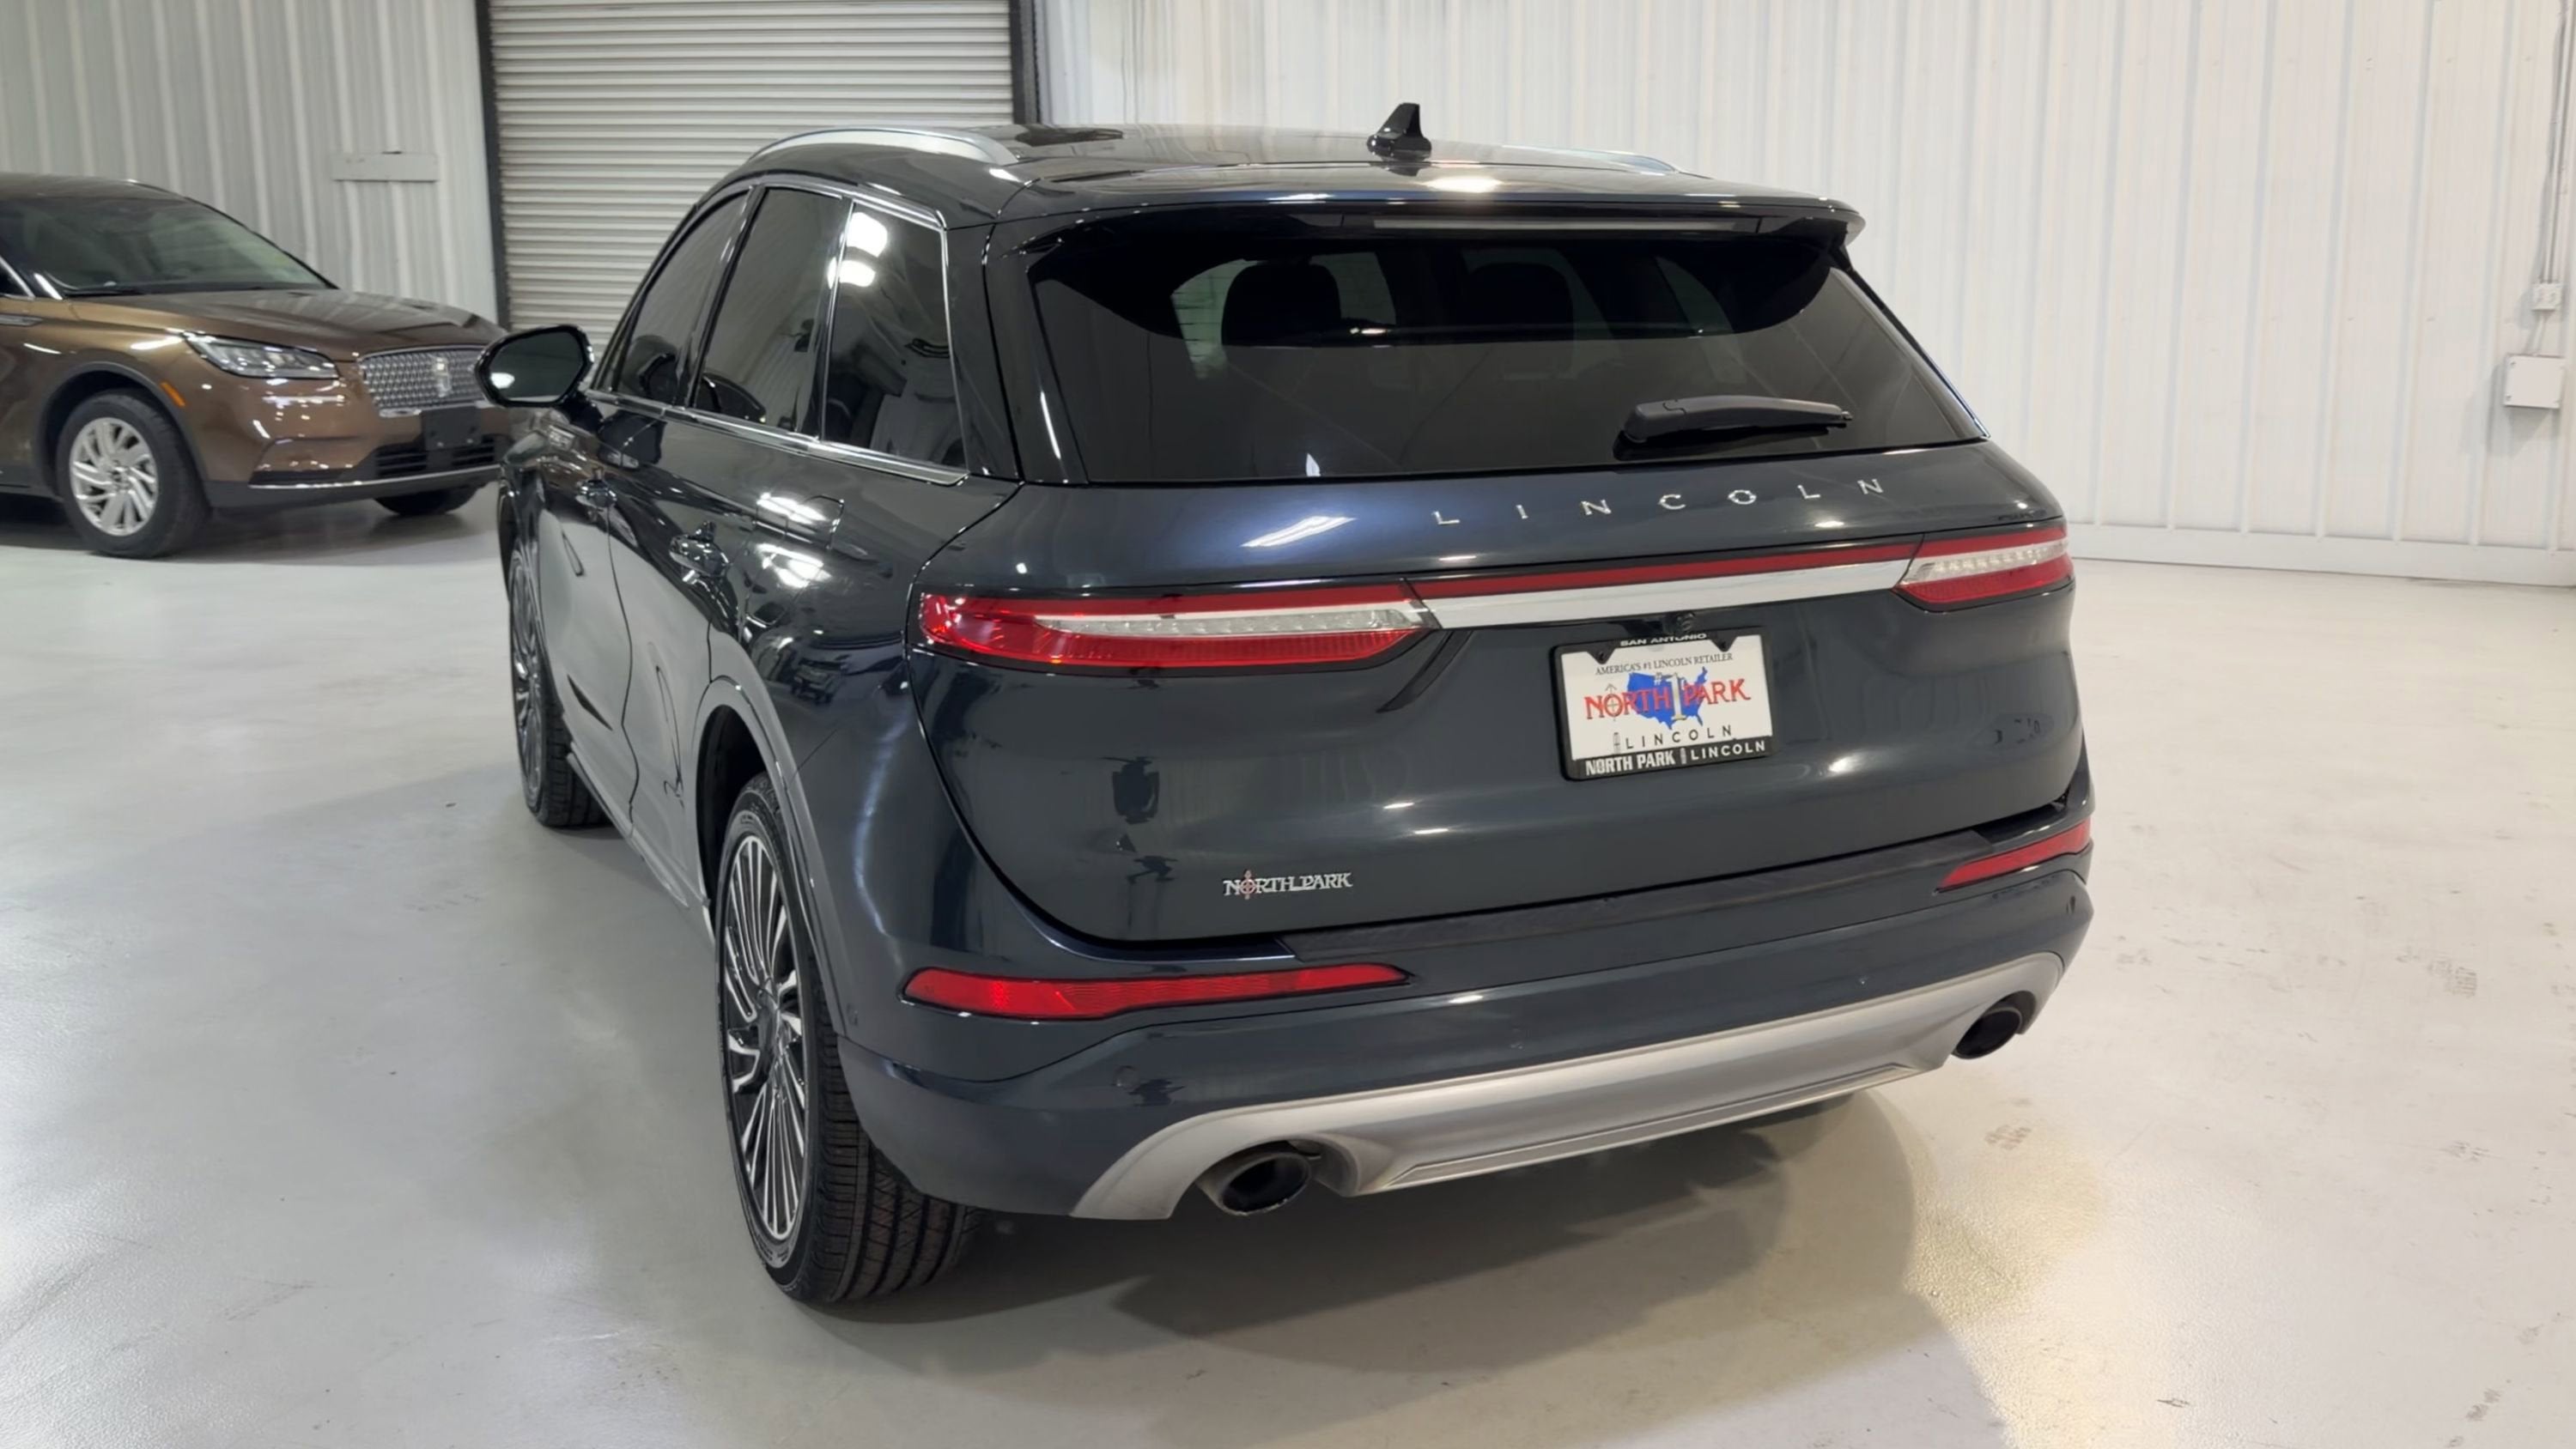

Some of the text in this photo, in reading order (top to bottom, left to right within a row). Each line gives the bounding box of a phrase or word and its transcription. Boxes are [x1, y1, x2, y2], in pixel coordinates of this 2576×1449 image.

[1433, 478, 1884, 525] LINCOLN
[1650, 633, 1707, 644] ANTONIO
[1595, 652, 1733, 676] AMERICA'S #1 LINCOLN RETAILER
[1583, 679, 1751, 719] NORTH PARK
[1625, 724, 1732, 749] LINCOLN
[1585, 741, 1765, 776] NORTH PARK LINCOLN
